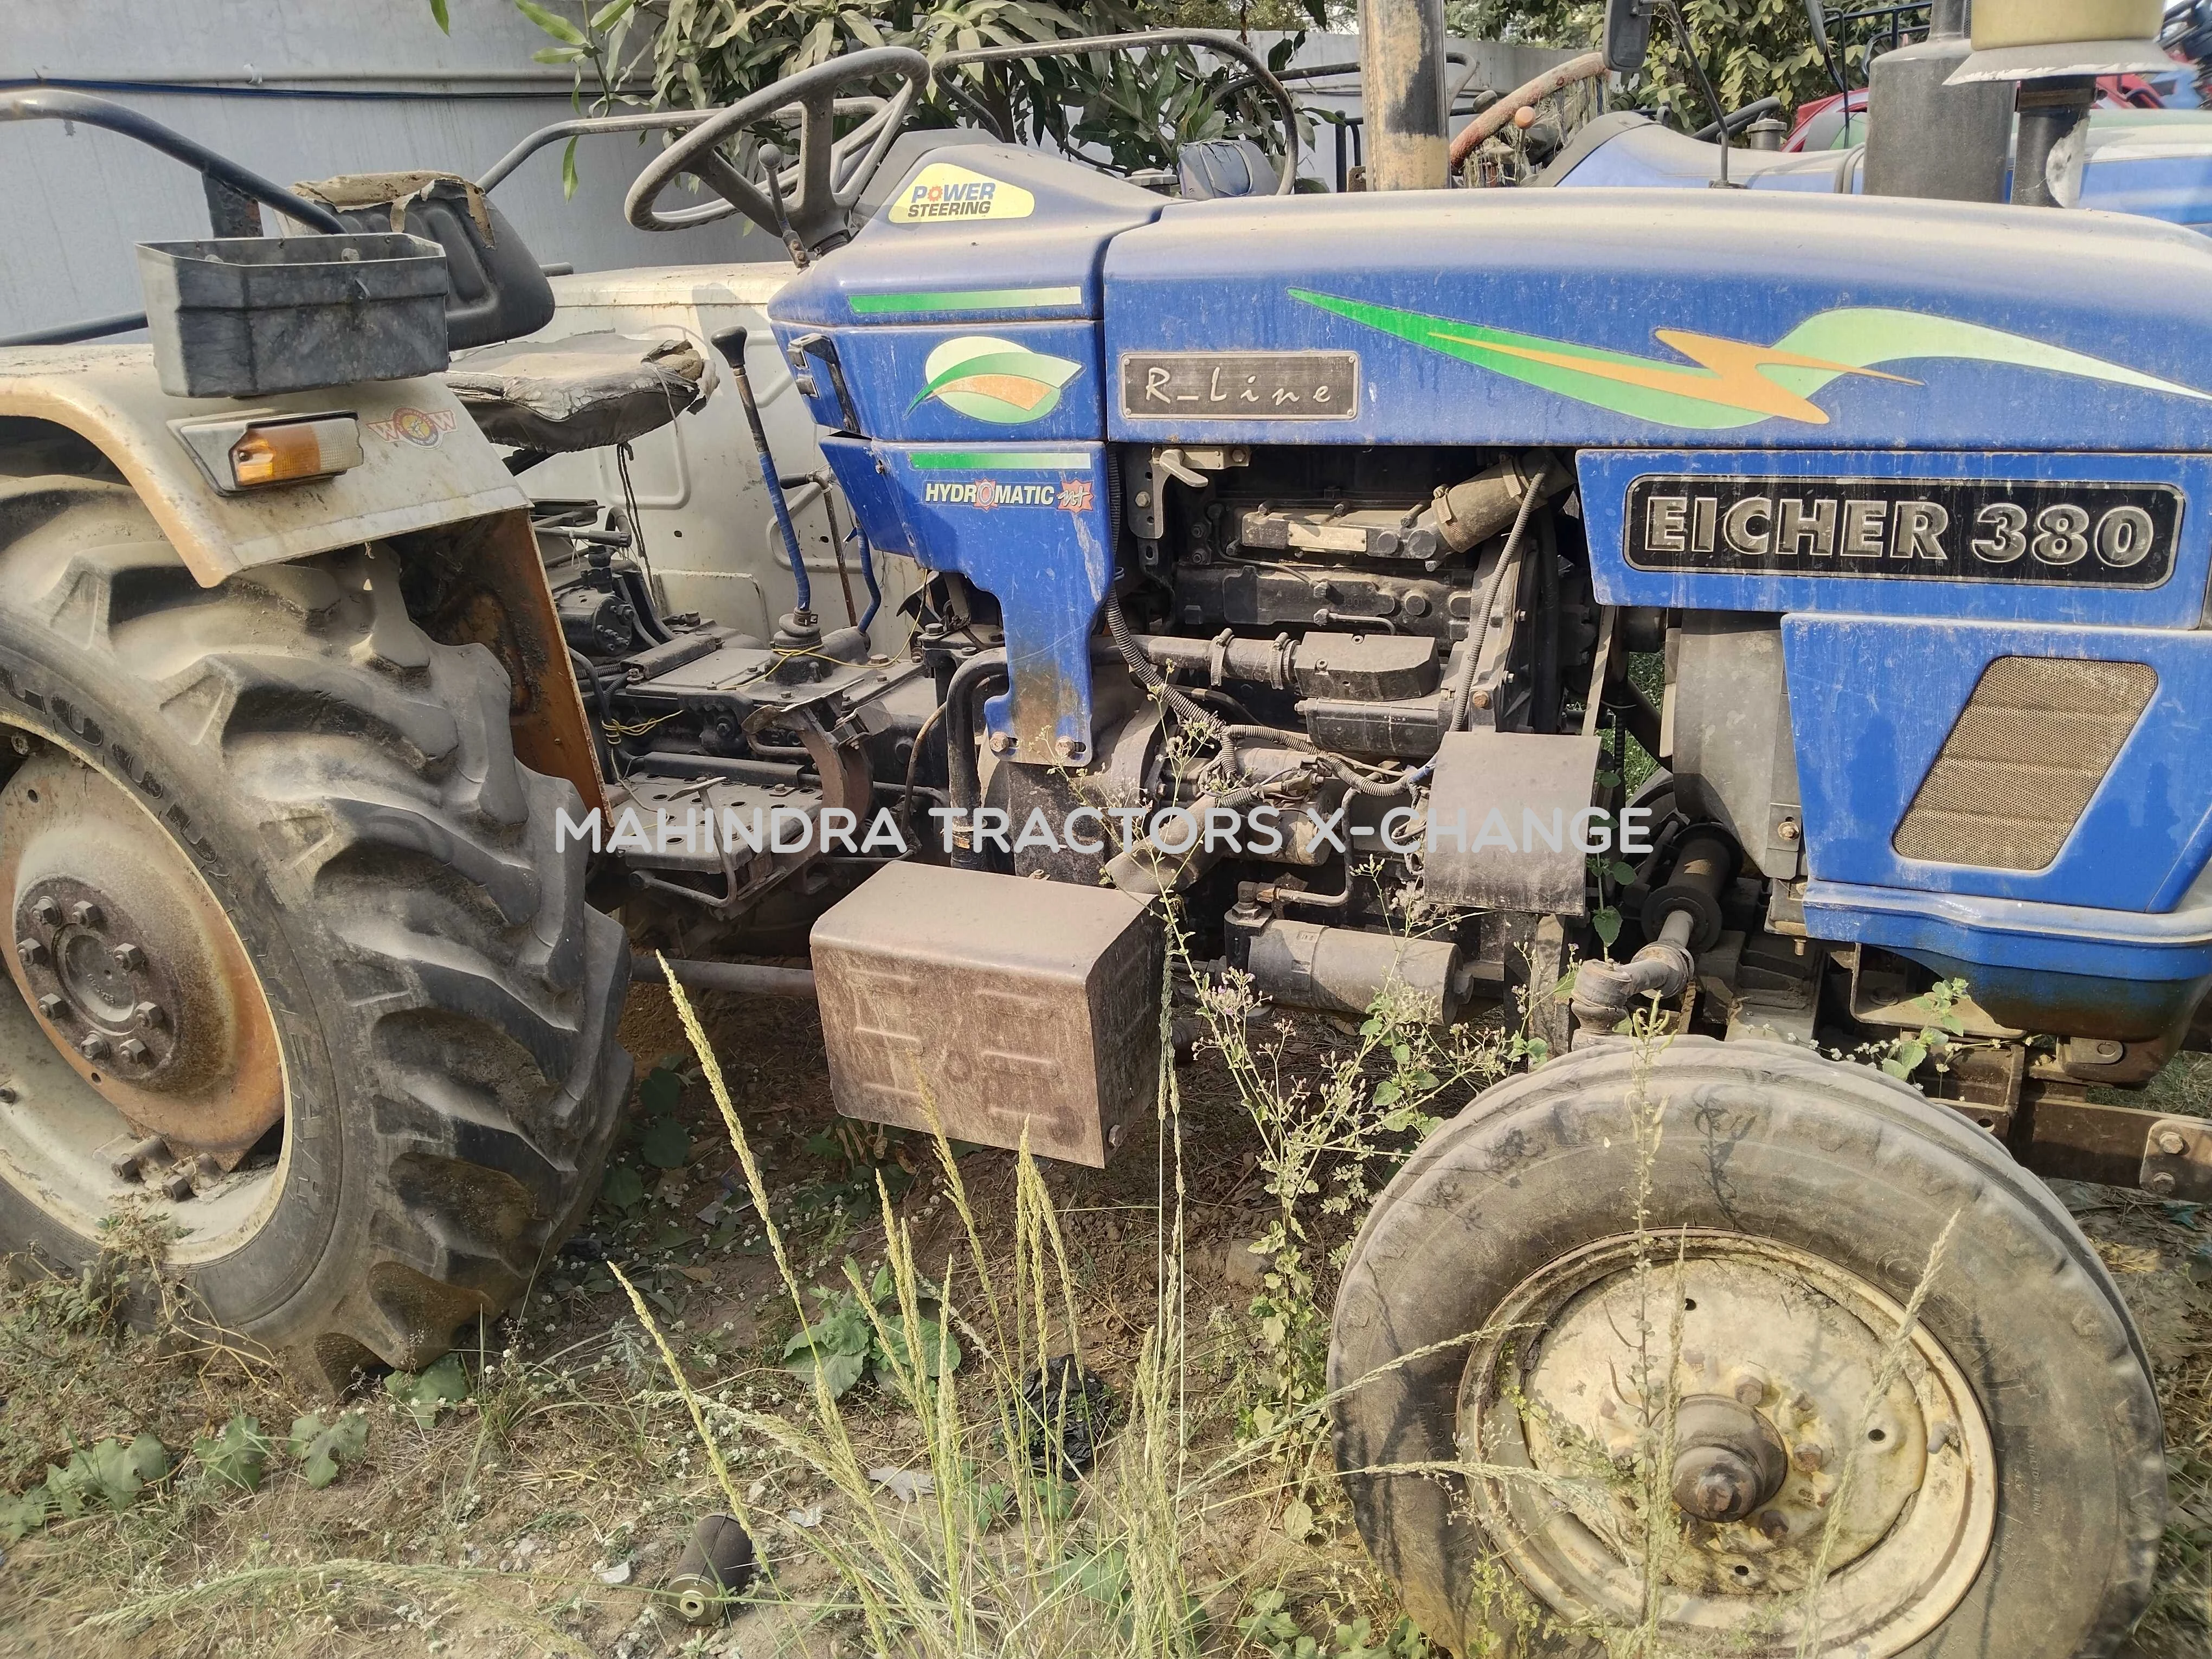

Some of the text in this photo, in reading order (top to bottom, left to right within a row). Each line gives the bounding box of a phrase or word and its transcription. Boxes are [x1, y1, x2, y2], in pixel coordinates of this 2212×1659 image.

[911, 183, 996, 203] POWER
[908, 201, 991, 217] STEERING
[925, 481, 1055, 506] HYDROMATIC
[1643, 496, 2155, 568] EICHER 380
